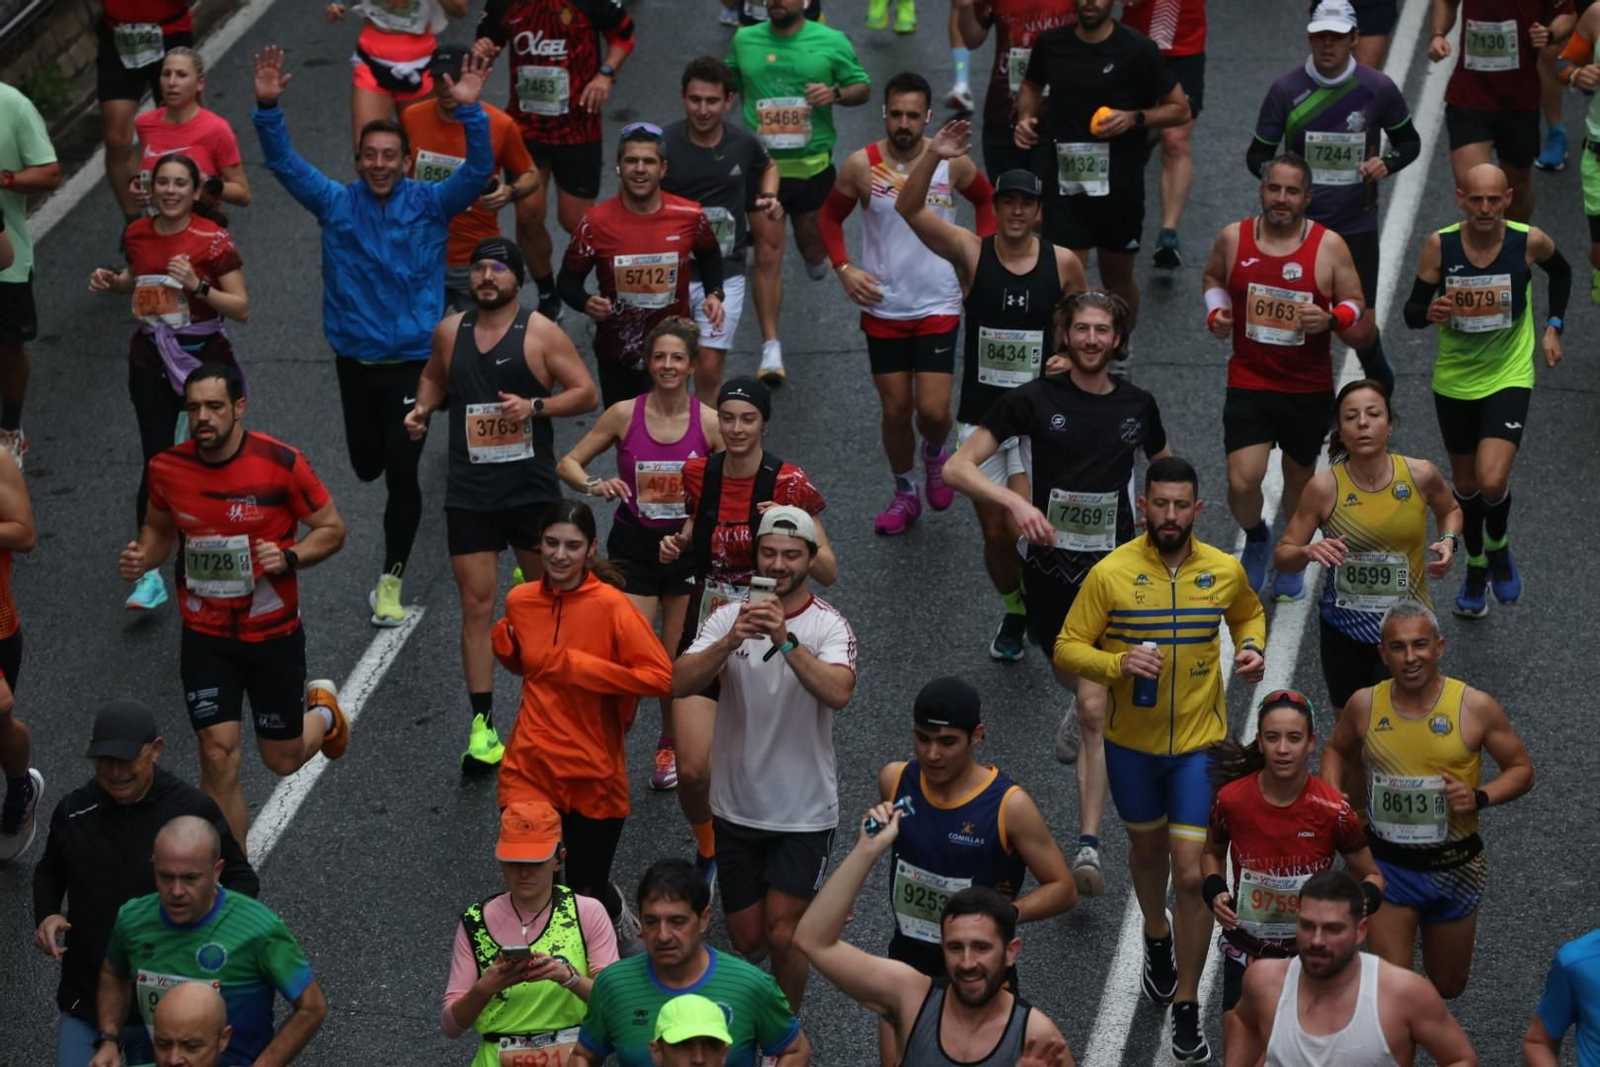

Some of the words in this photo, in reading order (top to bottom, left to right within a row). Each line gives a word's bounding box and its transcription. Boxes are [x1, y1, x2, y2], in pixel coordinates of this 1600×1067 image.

[1471, 33, 1505, 50] 7130
[523, 78, 556, 95] 7463
[764, 110, 800, 126] 5468
[1315, 145, 1352, 162] 7244
[1062, 155, 1095, 173] 9132
[625, 267, 665, 285] 5712
[1455, 290, 1496, 308] 6079
[1255, 299, 1296, 321] 6163
[987, 342, 1028, 362] 8434
[476, 418, 519, 437] 3763
[647, 475, 680, 494] 476
[1060, 505, 1103, 526] 7269
[718, 529, 752, 543] MAR
[190, 552, 234, 572] 7728
[1346, 565, 1391, 586] 8599
[1382, 790, 1429, 814] 8613
[948, 831, 985, 846] COMILLAS
[1251, 887, 1300, 915] 9759
